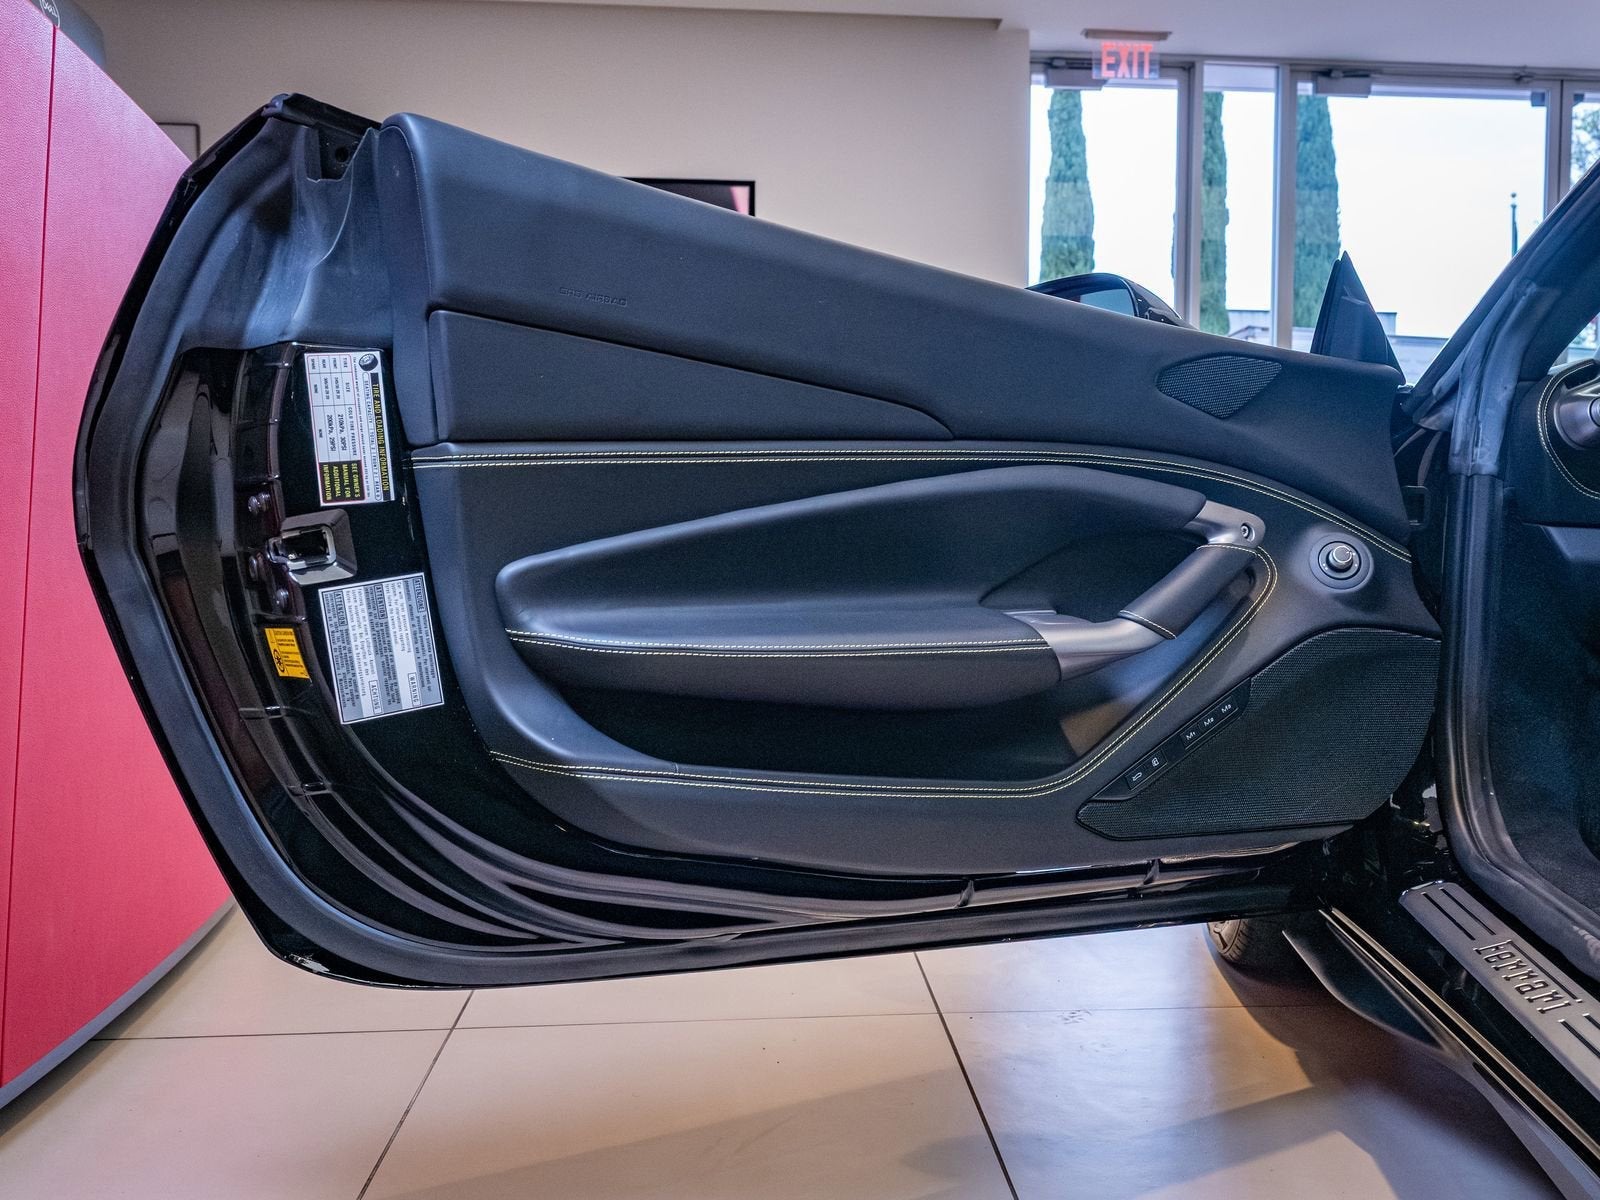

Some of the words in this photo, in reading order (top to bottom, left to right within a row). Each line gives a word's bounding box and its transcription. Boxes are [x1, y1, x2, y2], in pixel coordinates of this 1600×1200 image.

[1101, 42, 1153, 78] EXIT
[586, 292, 628, 307] AIRBAG
[326, 415, 334, 435] 200kPa,
[376, 416, 384, 444] LOADING
[323, 464, 333, 500] INFORMATION
[332, 466, 342, 497] ADDITIONAL
[342, 464, 350, 486] MANUAL
[379, 446, 389, 491] INFORMATION
[352, 474, 361, 498] OWNER'S
[376, 586, 386, 618] ATTENTION
[414, 580, 425, 610] ATTENZIONE
[371, 684, 380, 710] ACHTUNG
[410, 676, 419, 702] WARNING
[1473, 940, 1580, 1014] Ferrari
